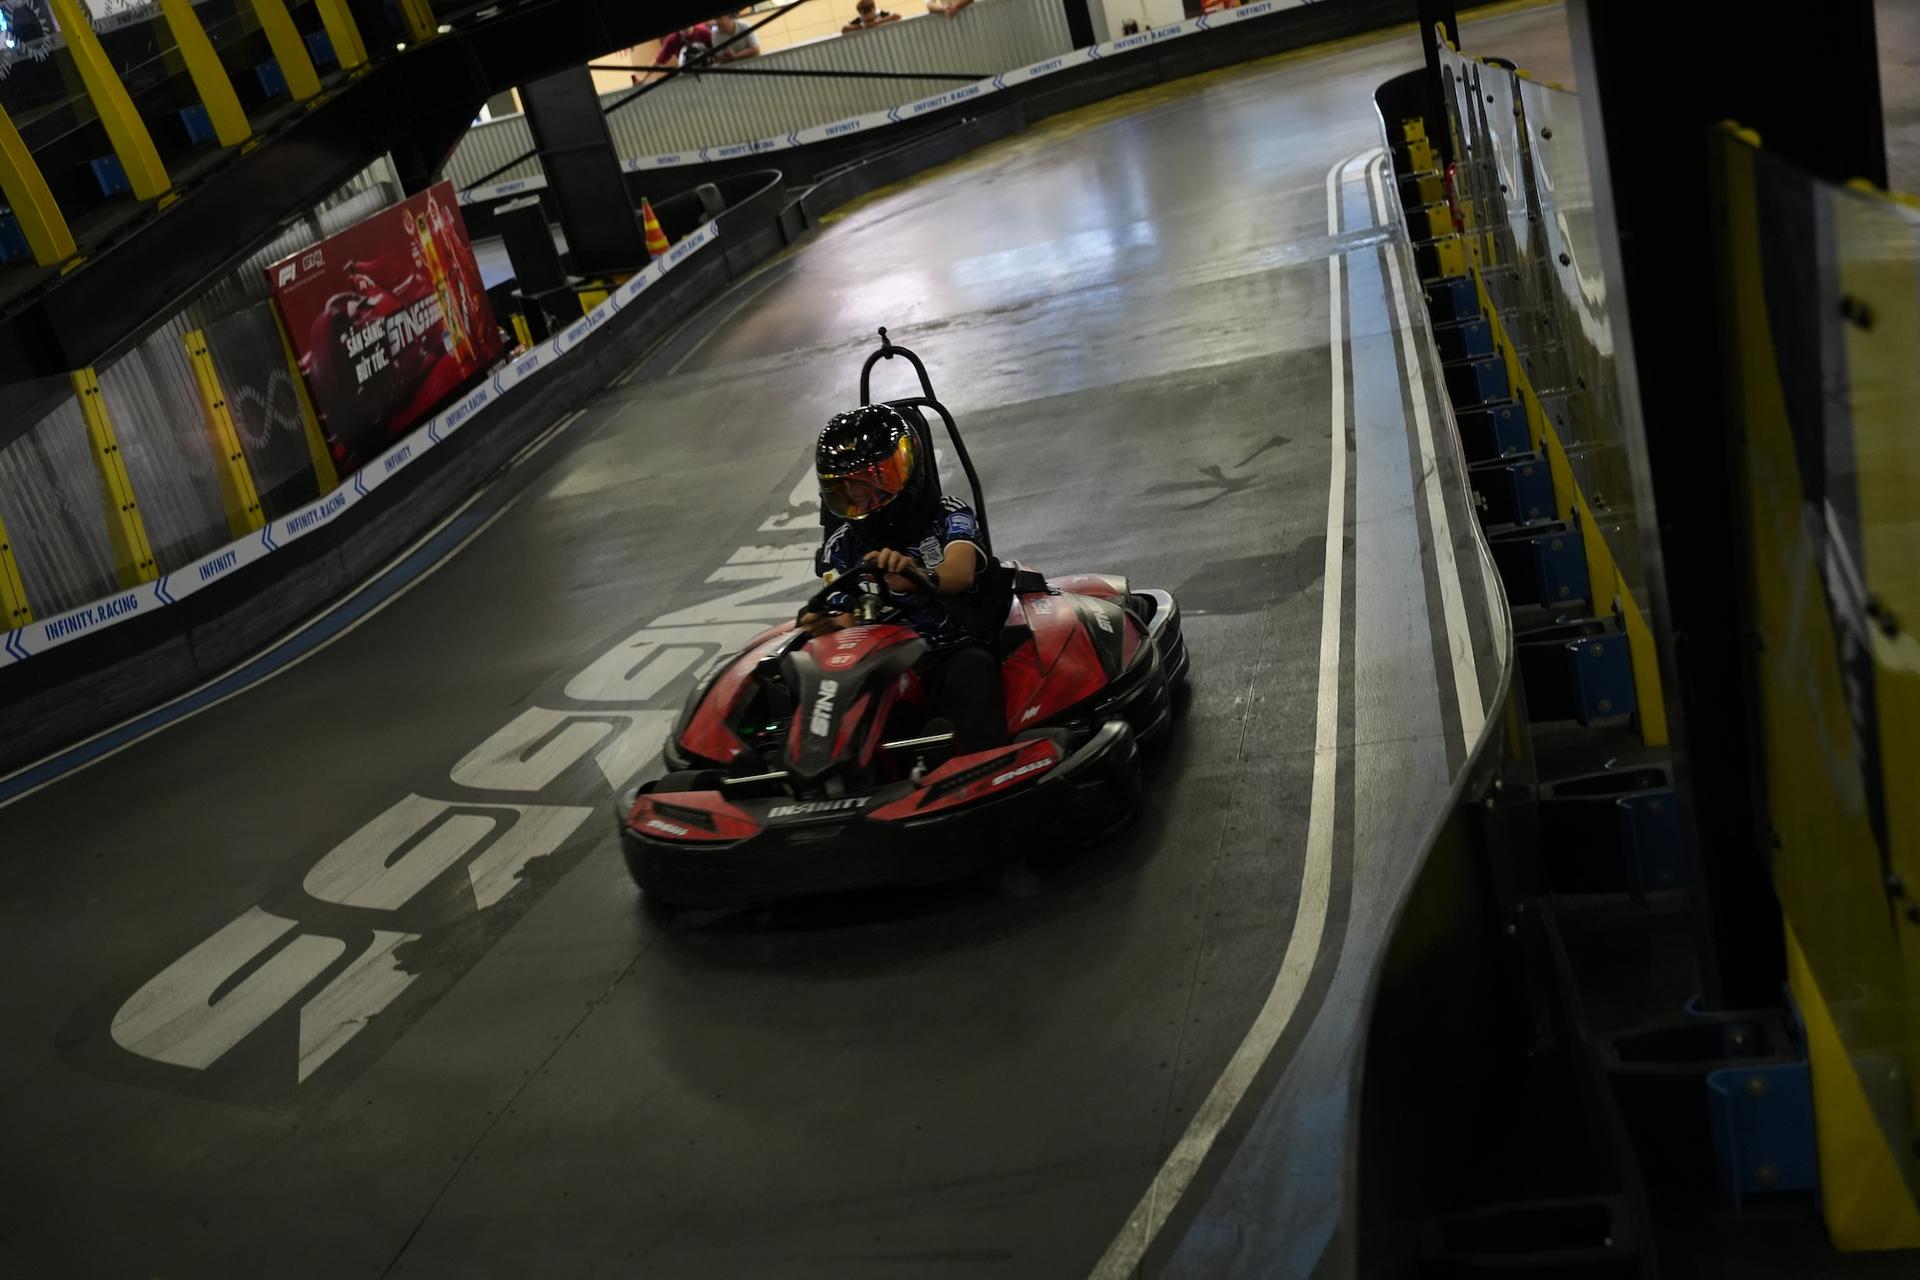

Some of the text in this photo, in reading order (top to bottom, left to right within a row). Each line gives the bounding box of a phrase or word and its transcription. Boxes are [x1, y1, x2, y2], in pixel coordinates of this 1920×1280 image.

[287, 492, 346, 536] INFINITY.RACING
[199, 550, 238, 581] INFINITY
[45, 594, 138, 641] INFINITY.RACING
[809, 679, 839, 737] STING
